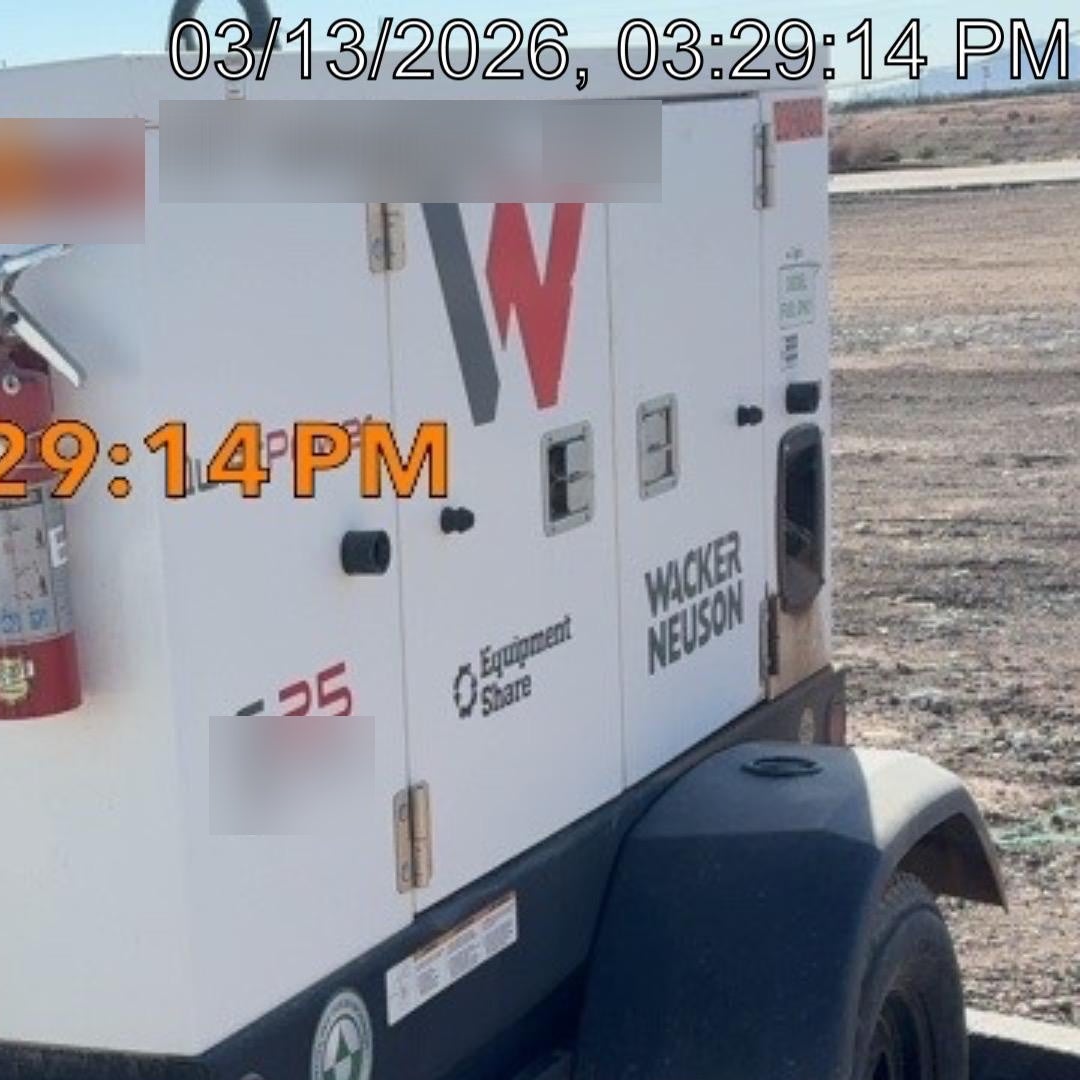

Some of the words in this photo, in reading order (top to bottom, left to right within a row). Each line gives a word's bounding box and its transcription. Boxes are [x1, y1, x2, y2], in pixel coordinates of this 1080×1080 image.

[644, 530, 743, 618] WACKER
[480, 613, 573, 679] Equipment
[646, 579, 744, 676] NEUSON
[481, 674, 532, 718] Share
